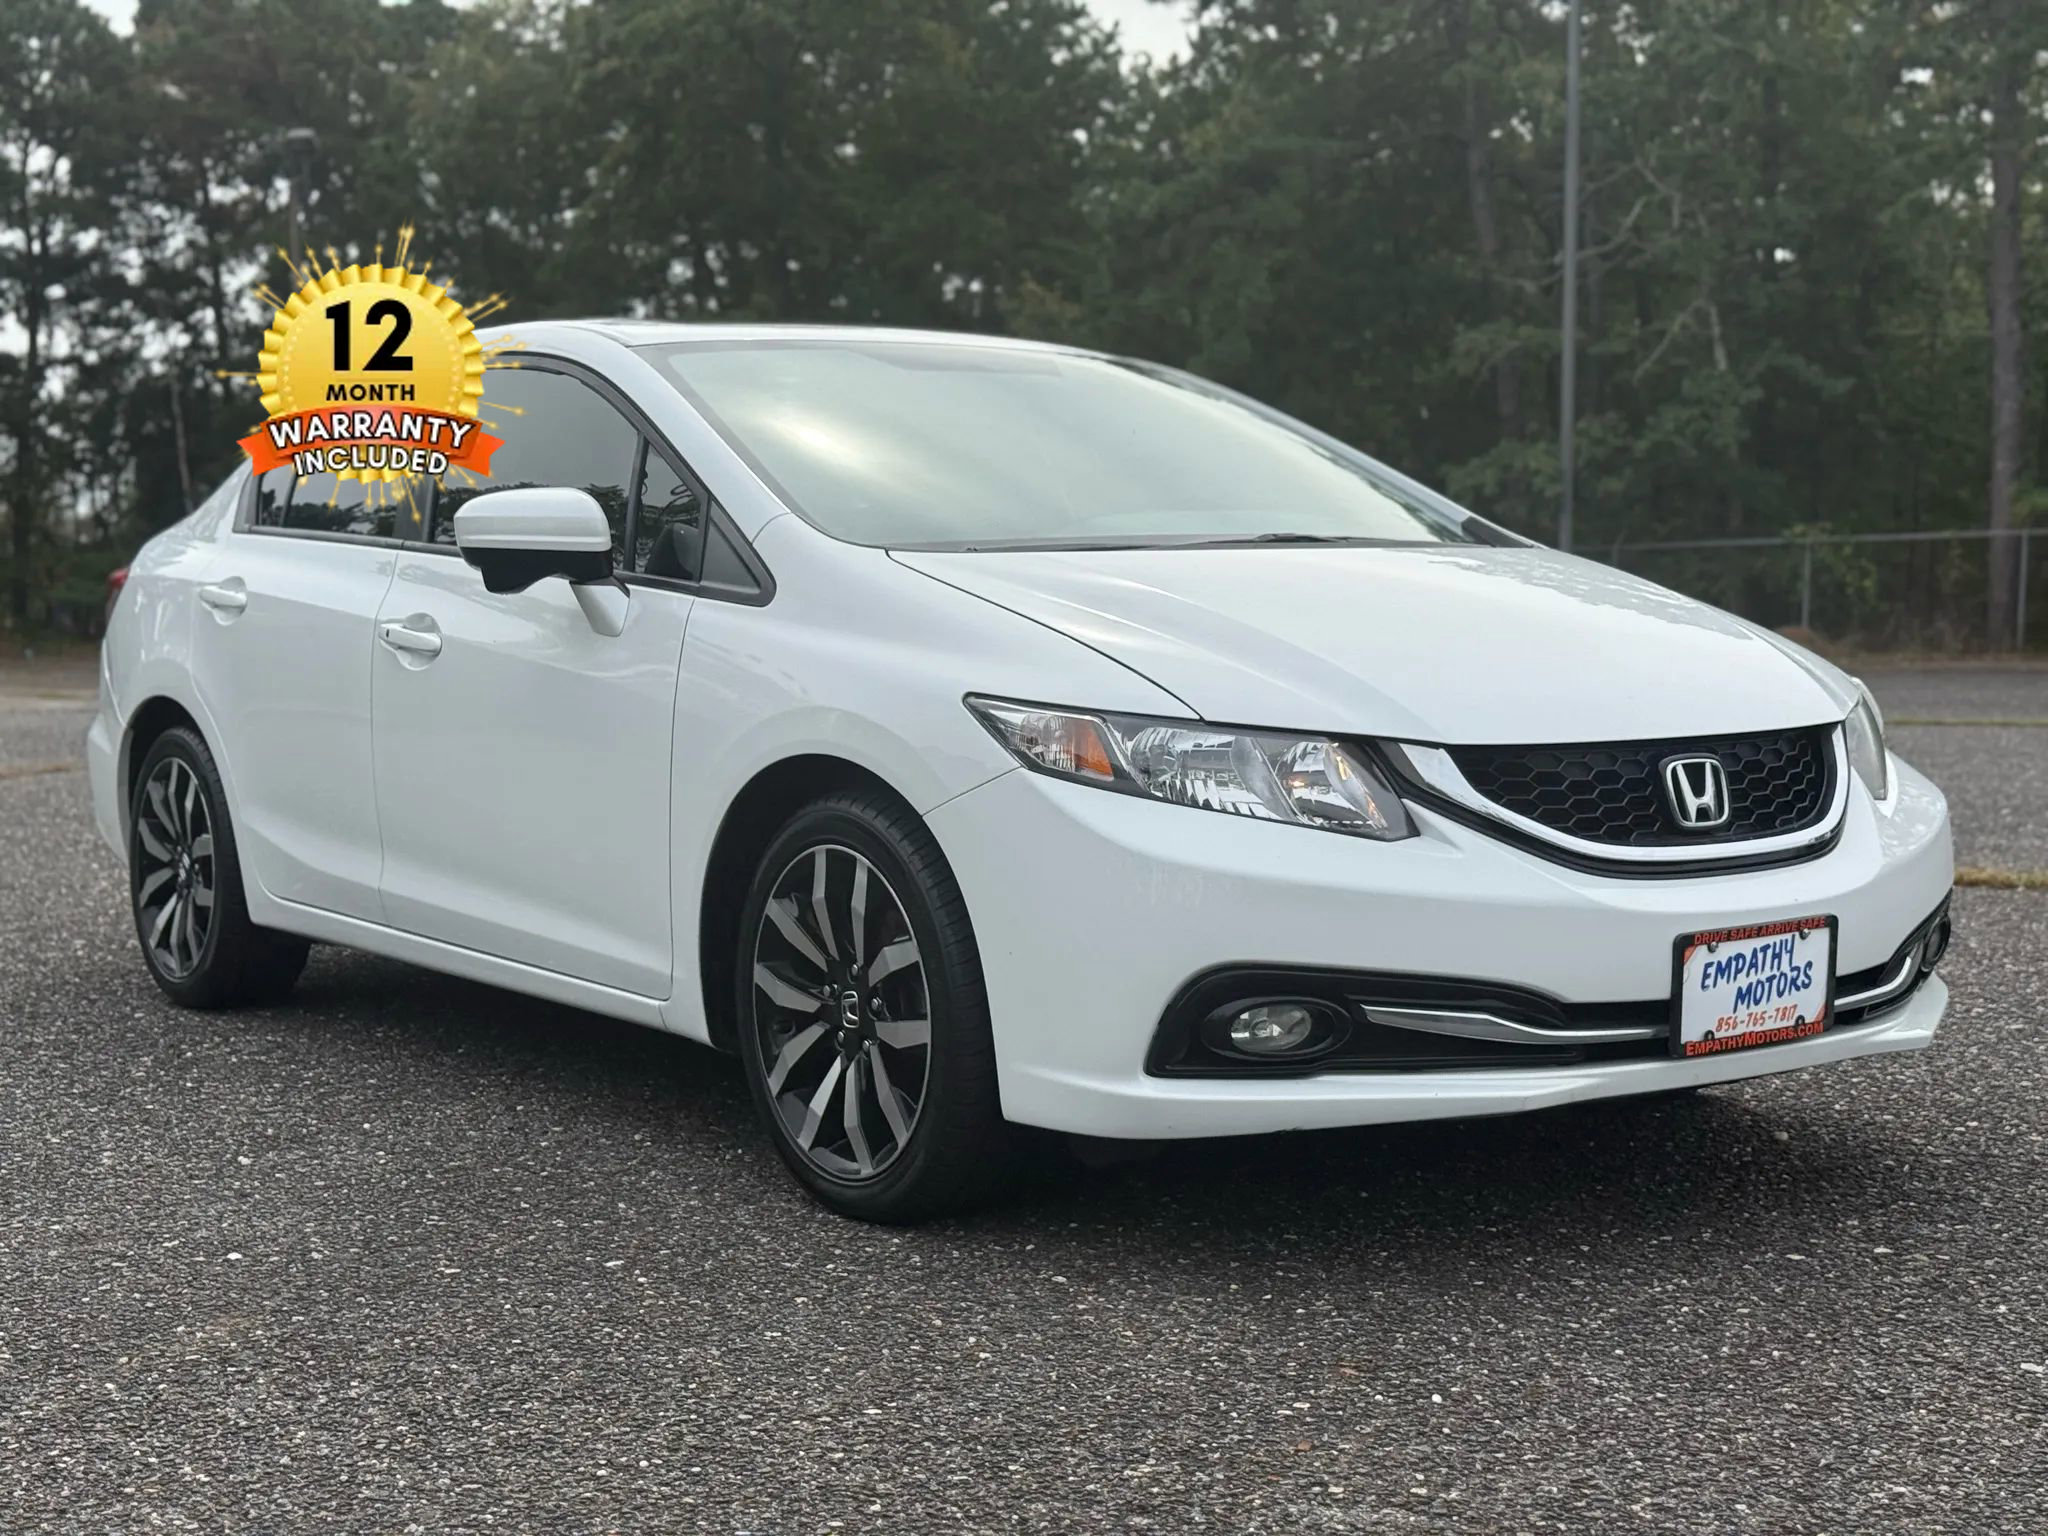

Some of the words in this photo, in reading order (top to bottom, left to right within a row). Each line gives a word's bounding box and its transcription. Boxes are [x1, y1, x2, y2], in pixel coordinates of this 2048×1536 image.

[1694, 931, 1728, 945] DRIVE
[1730, 926, 1758, 940] SAFE
[1759, 921, 1798, 937] ARRIVE
[1800, 917, 1826, 929] SAFE
[1701, 934, 1796, 992] EMPATHY
[1733, 960, 1813, 1014] MOTORS
[1715, 1004, 1798, 1033] 856-765-7817
